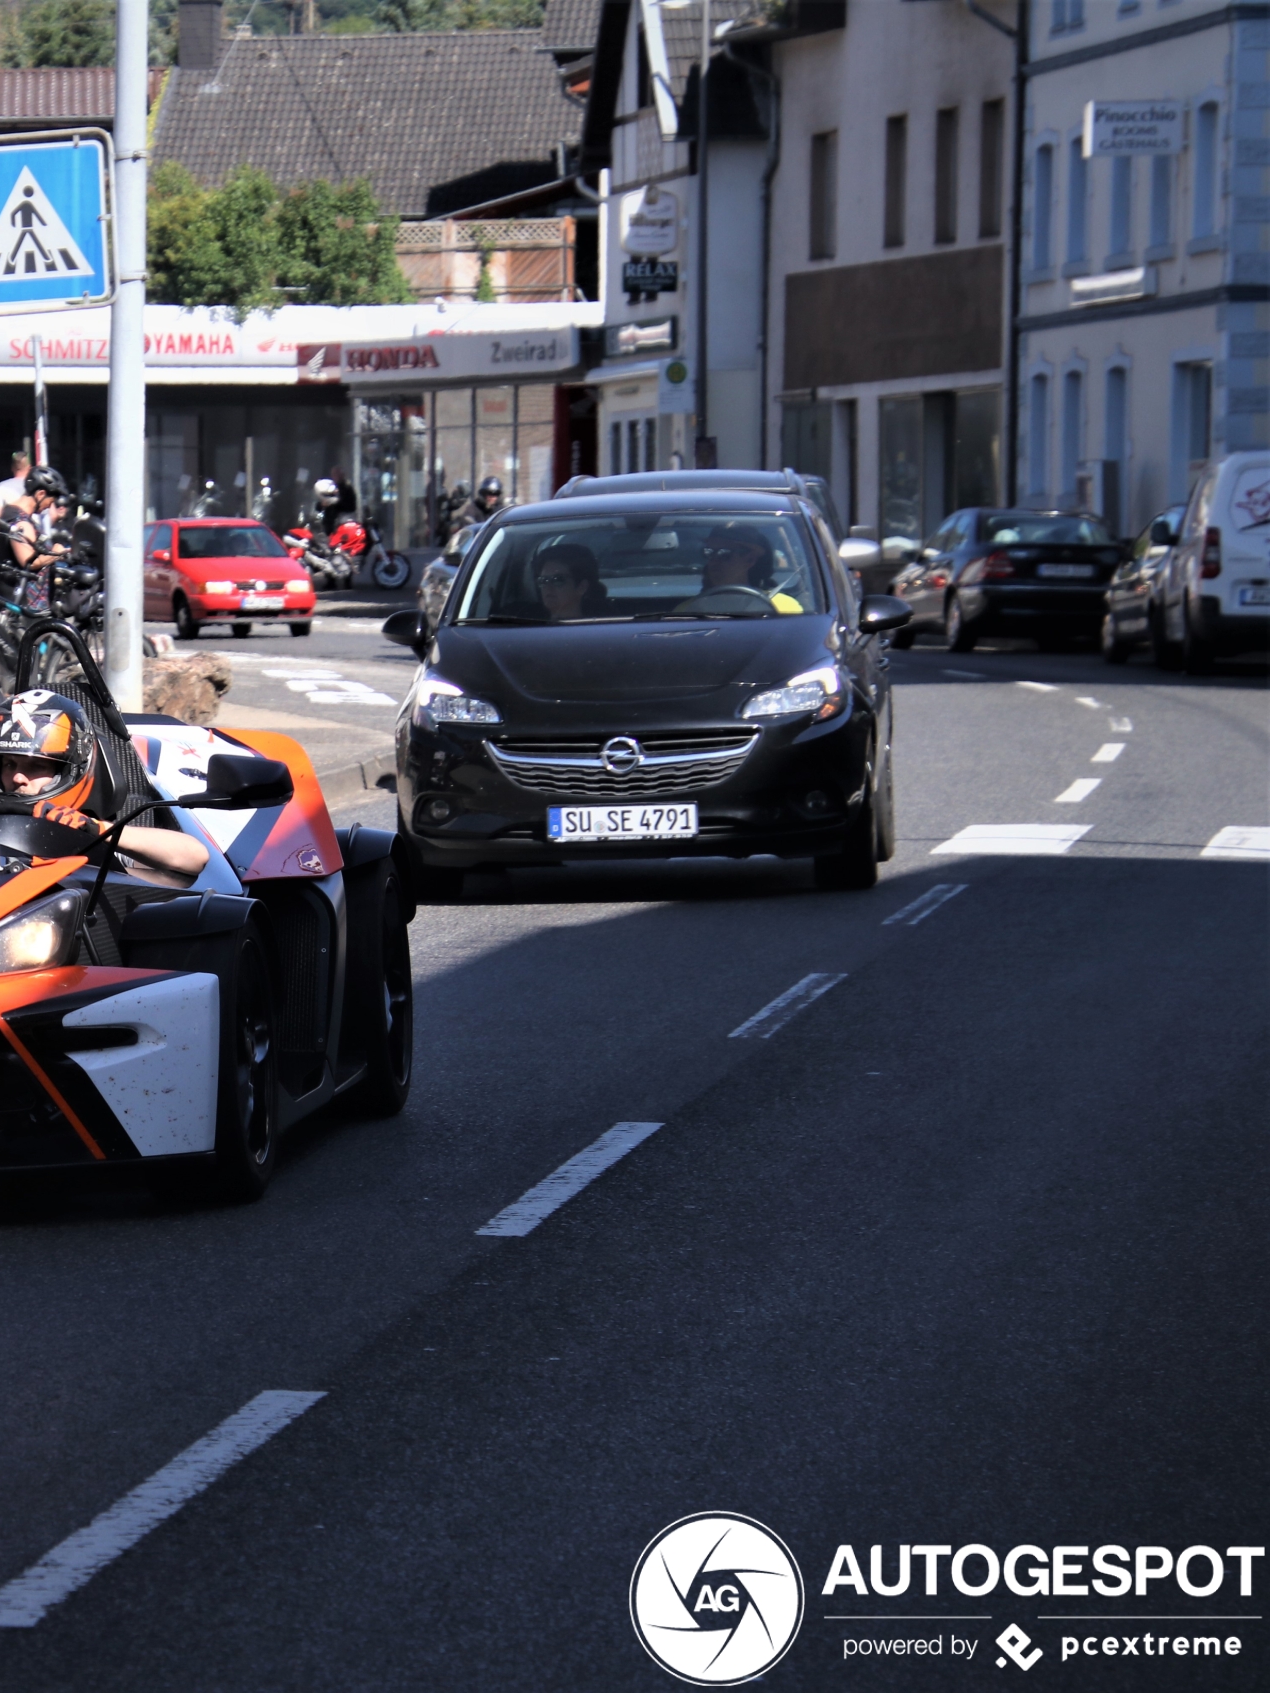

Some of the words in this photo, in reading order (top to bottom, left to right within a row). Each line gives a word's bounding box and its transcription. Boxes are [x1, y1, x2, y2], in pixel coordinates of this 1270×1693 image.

[1094, 105, 1177, 123] Pinocchio
[625, 263, 676, 277] RELAX
[9, 338, 108, 359] SCHMITZ
[154, 333, 234, 354] YAMAHA
[345, 345, 440, 372] HONDA
[491, 338, 557, 363] Zweirad
[0, 740, 33, 749] SHARK
[565, 811, 591, 833] SU
[607, 810, 633, 832] SE
[639, 808, 692, 831] 4791
